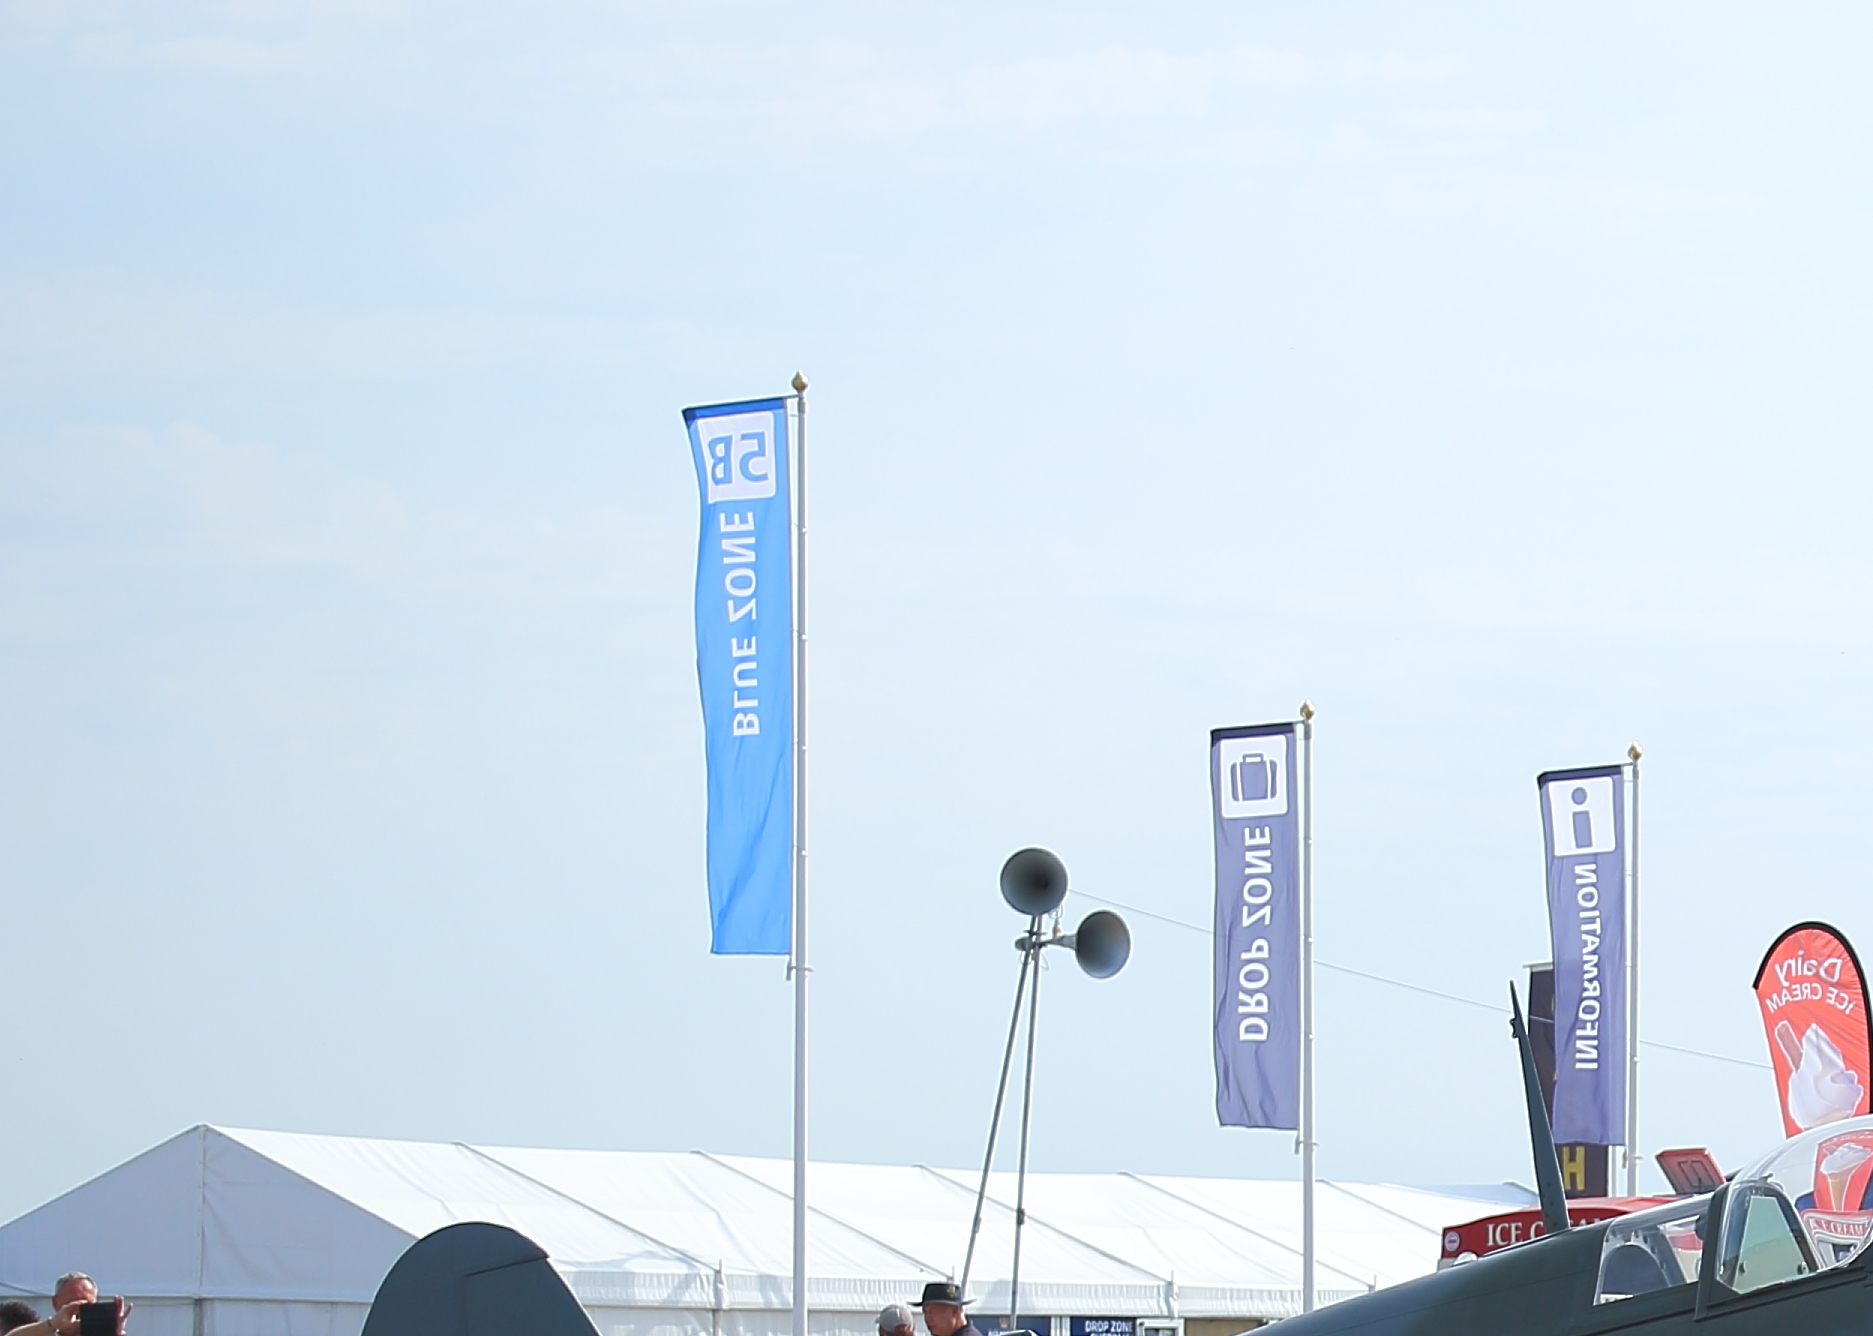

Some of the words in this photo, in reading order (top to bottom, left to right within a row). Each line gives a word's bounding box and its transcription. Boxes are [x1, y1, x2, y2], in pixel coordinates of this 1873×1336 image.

[1487, 1221, 1523, 1246] ICE
[1085, 1320, 1109, 1332] DROP
[1110, 1320, 1133, 1332] ZONE
